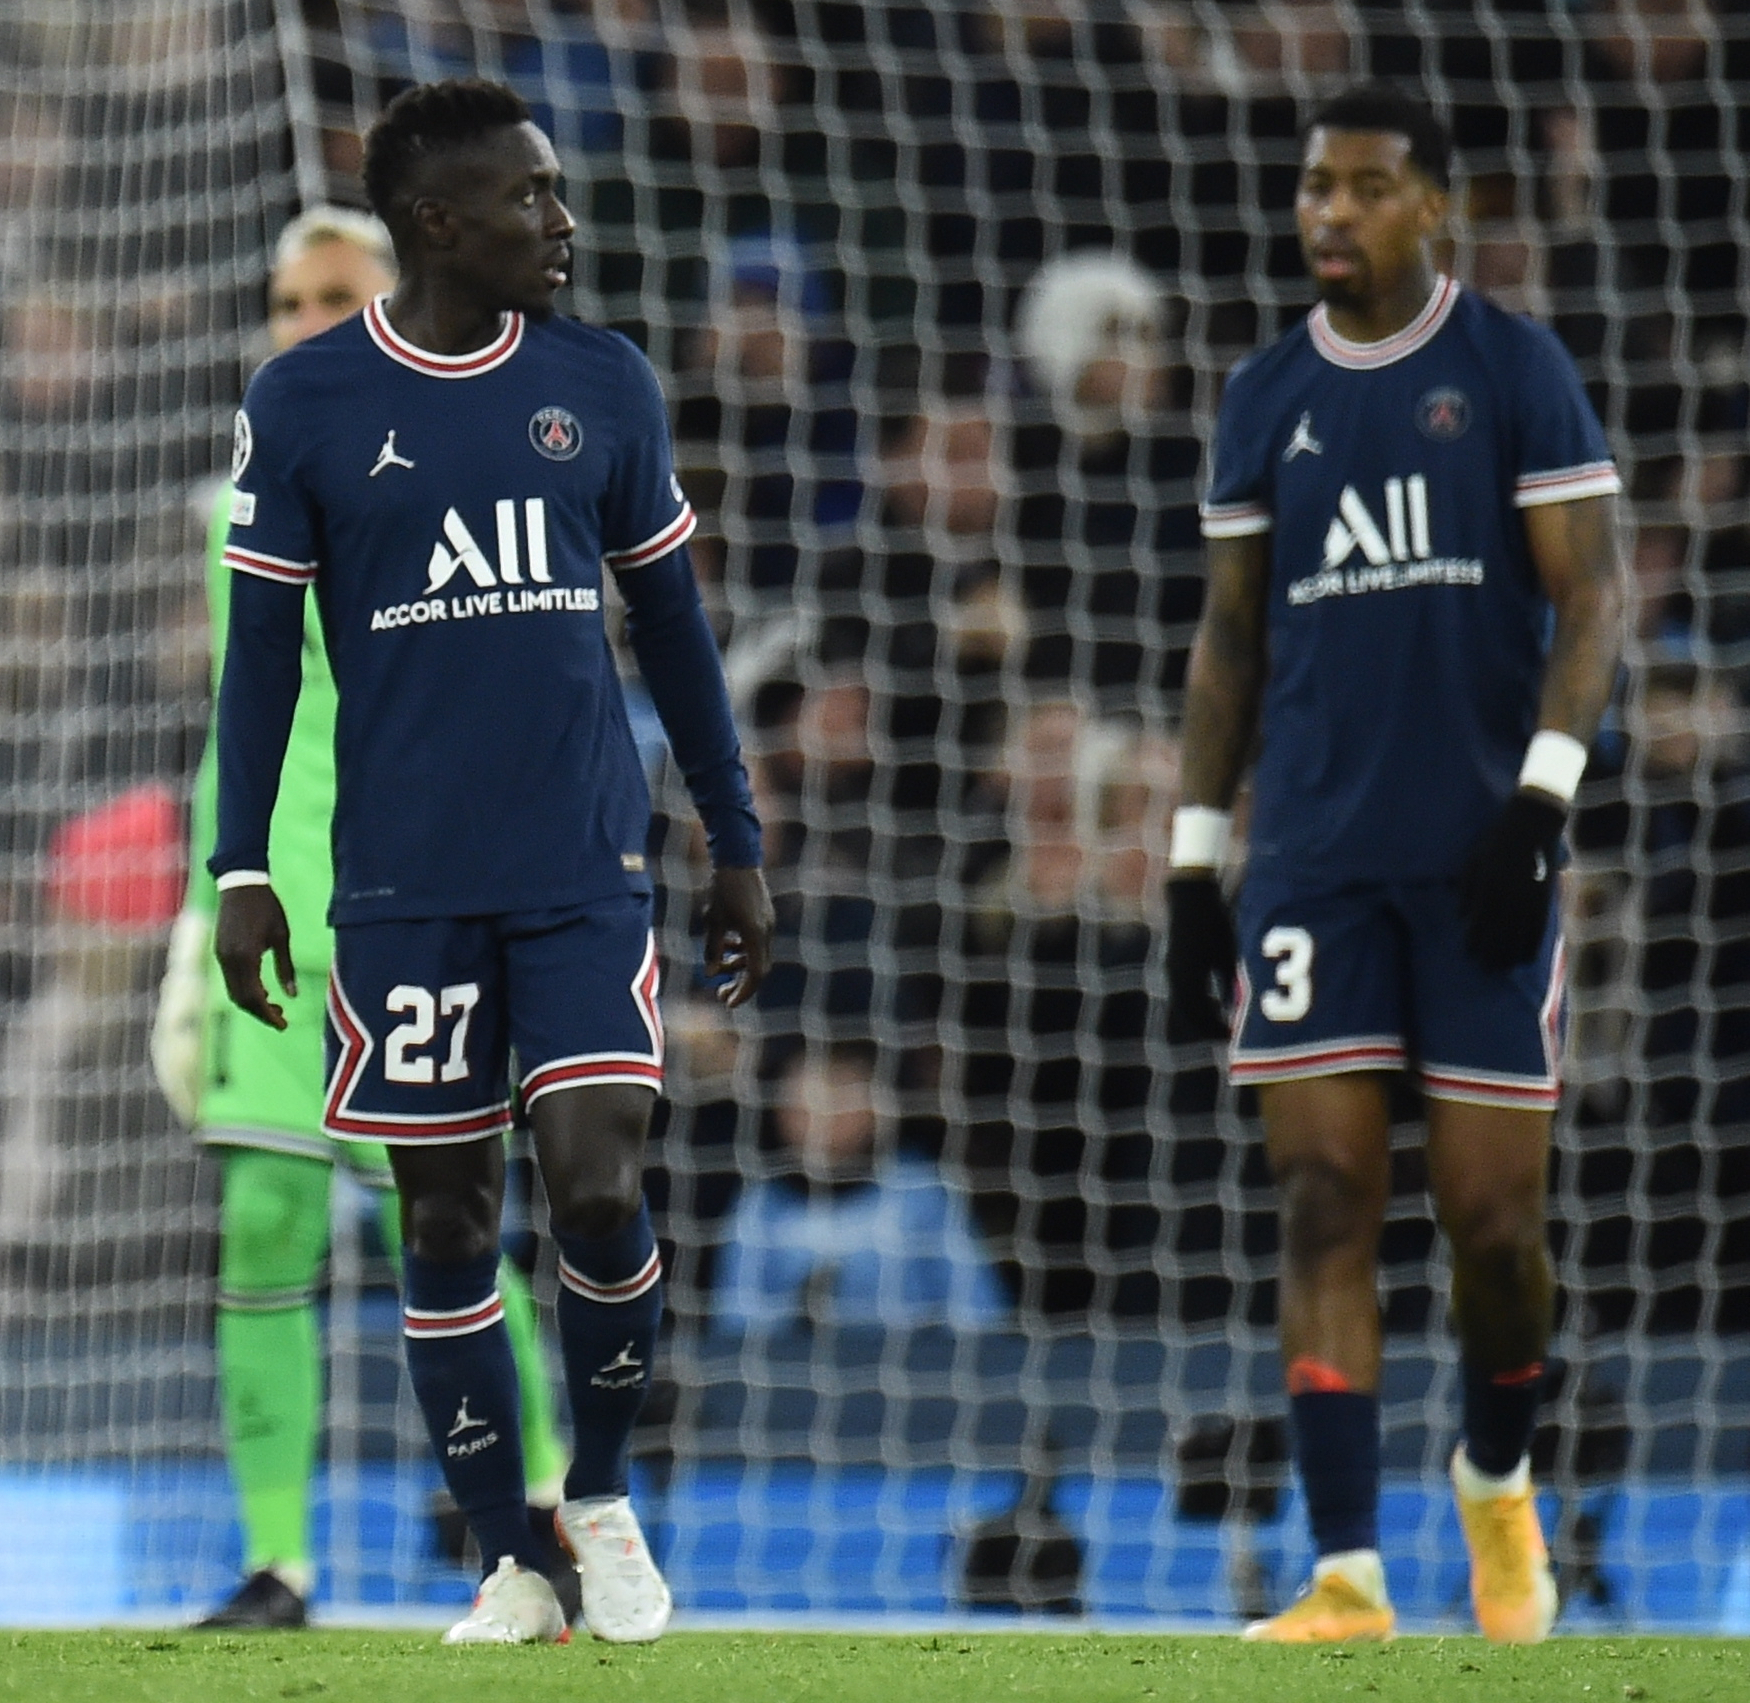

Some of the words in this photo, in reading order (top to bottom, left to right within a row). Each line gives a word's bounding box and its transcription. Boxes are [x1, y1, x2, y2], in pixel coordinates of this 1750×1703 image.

[370, 598, 448, 631] ACCOR
[452, 591, 502, 618] LIVE
[507, 588, 599, 613] LIMITLESS
[1260, 926, 1315, 1023] 3
[384, 982, 480, 1084] 27
[447, 1432, 498, 1457] PARIS
